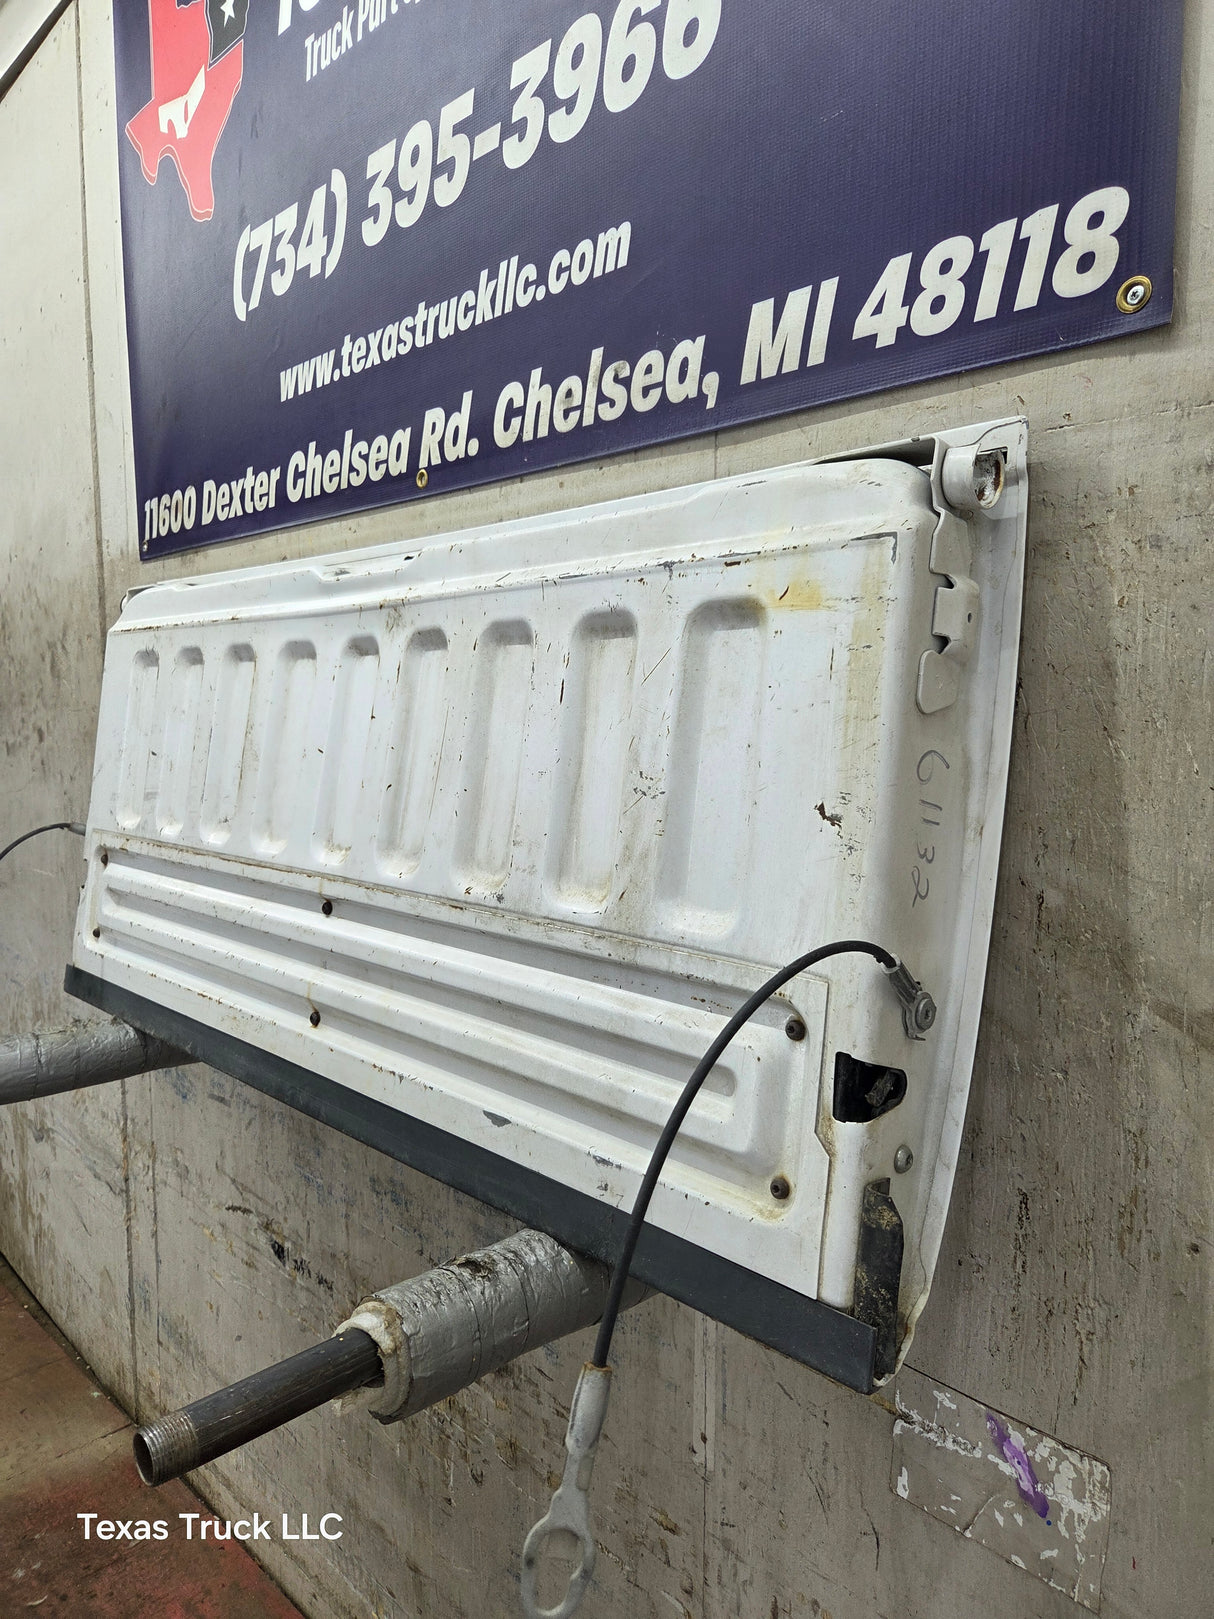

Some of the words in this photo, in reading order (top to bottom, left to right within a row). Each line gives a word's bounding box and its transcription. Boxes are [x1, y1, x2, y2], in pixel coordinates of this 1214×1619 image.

[234, 168, 349, 321] (734)
[361, 0, 723, 247] 395-3966
[304, 5, 355, 83] Truck
[143, 483, 197, 543] 11600
[201, 465, 281, 526] Dexter
[286, 426, 412, 503] Chelsea
[418, 389, 480, 469] Rd.
[493, 334, 720, 450] Chelsea,
[739, 275, 840, 386] MI
[851, 186, 1131, 349] 48118
[280, 220, 632, 403] www.texastruckllc.com
